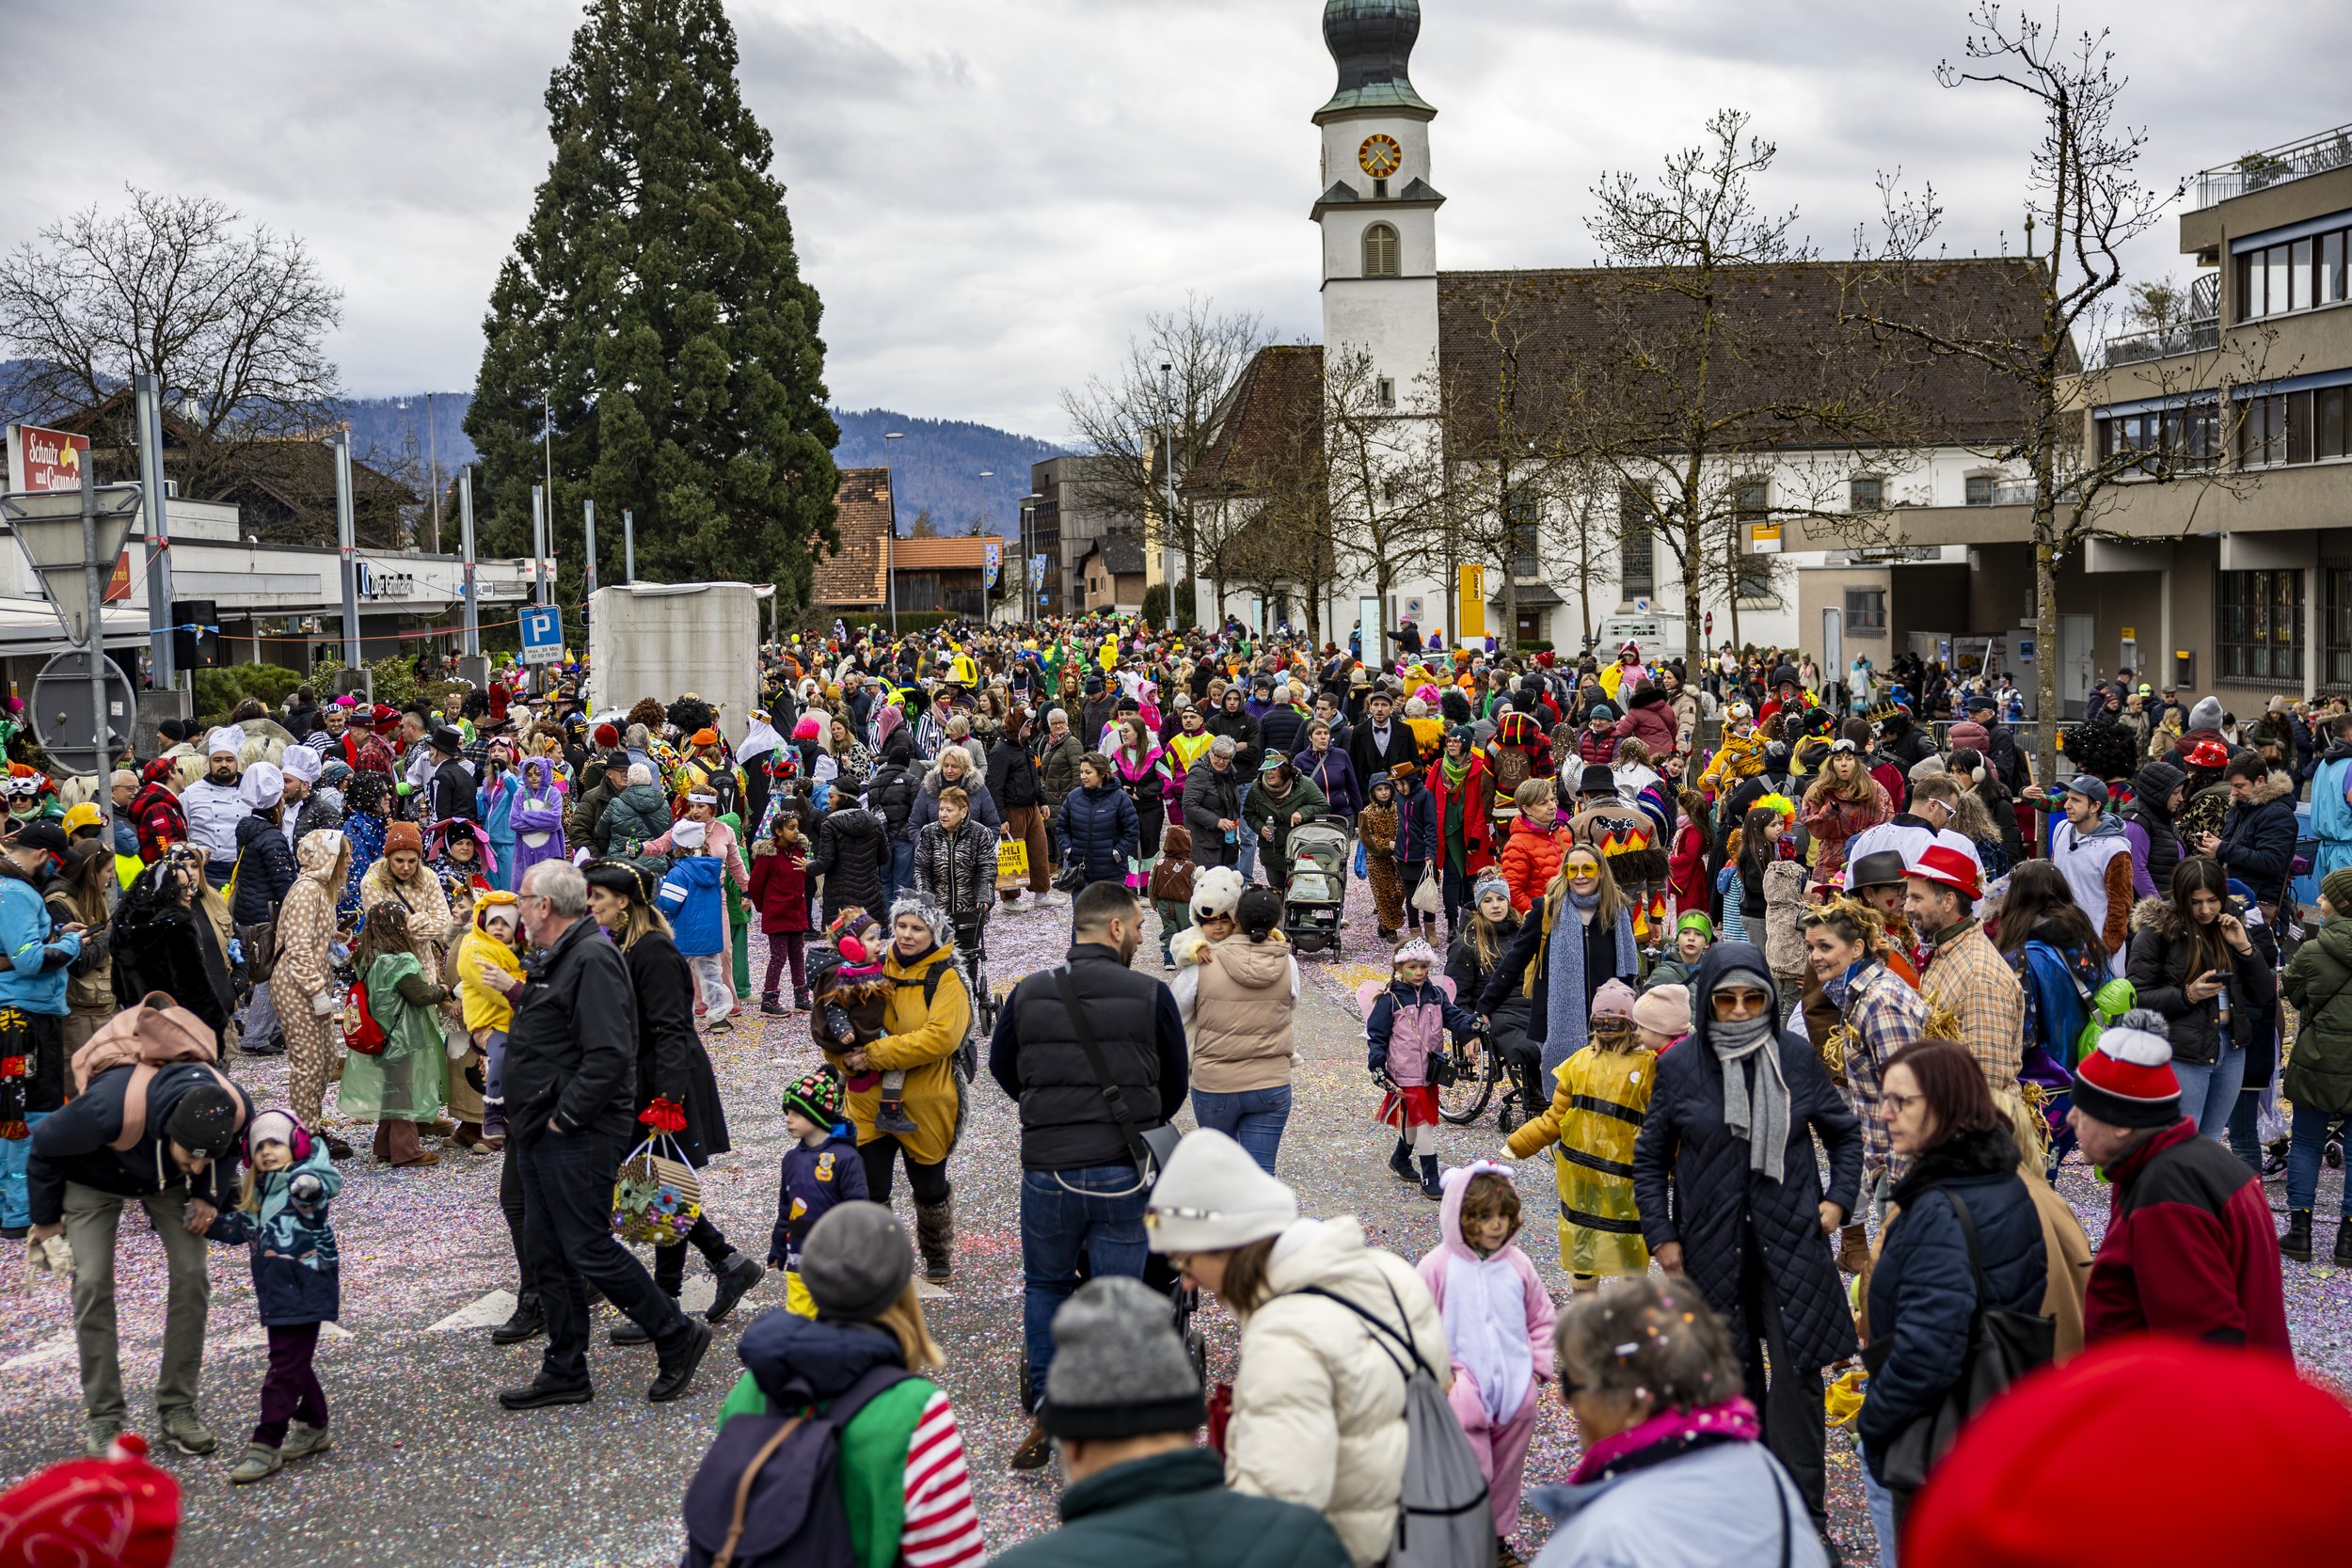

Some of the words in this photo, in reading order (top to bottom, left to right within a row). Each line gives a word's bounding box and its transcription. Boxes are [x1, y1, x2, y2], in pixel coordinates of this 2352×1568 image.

[29, 433, 58, 466] Schnitz
[35, 469, 47, 484] und
[47, 466, 82, 490] Gwunde
[532, 614, 551, 642] P
